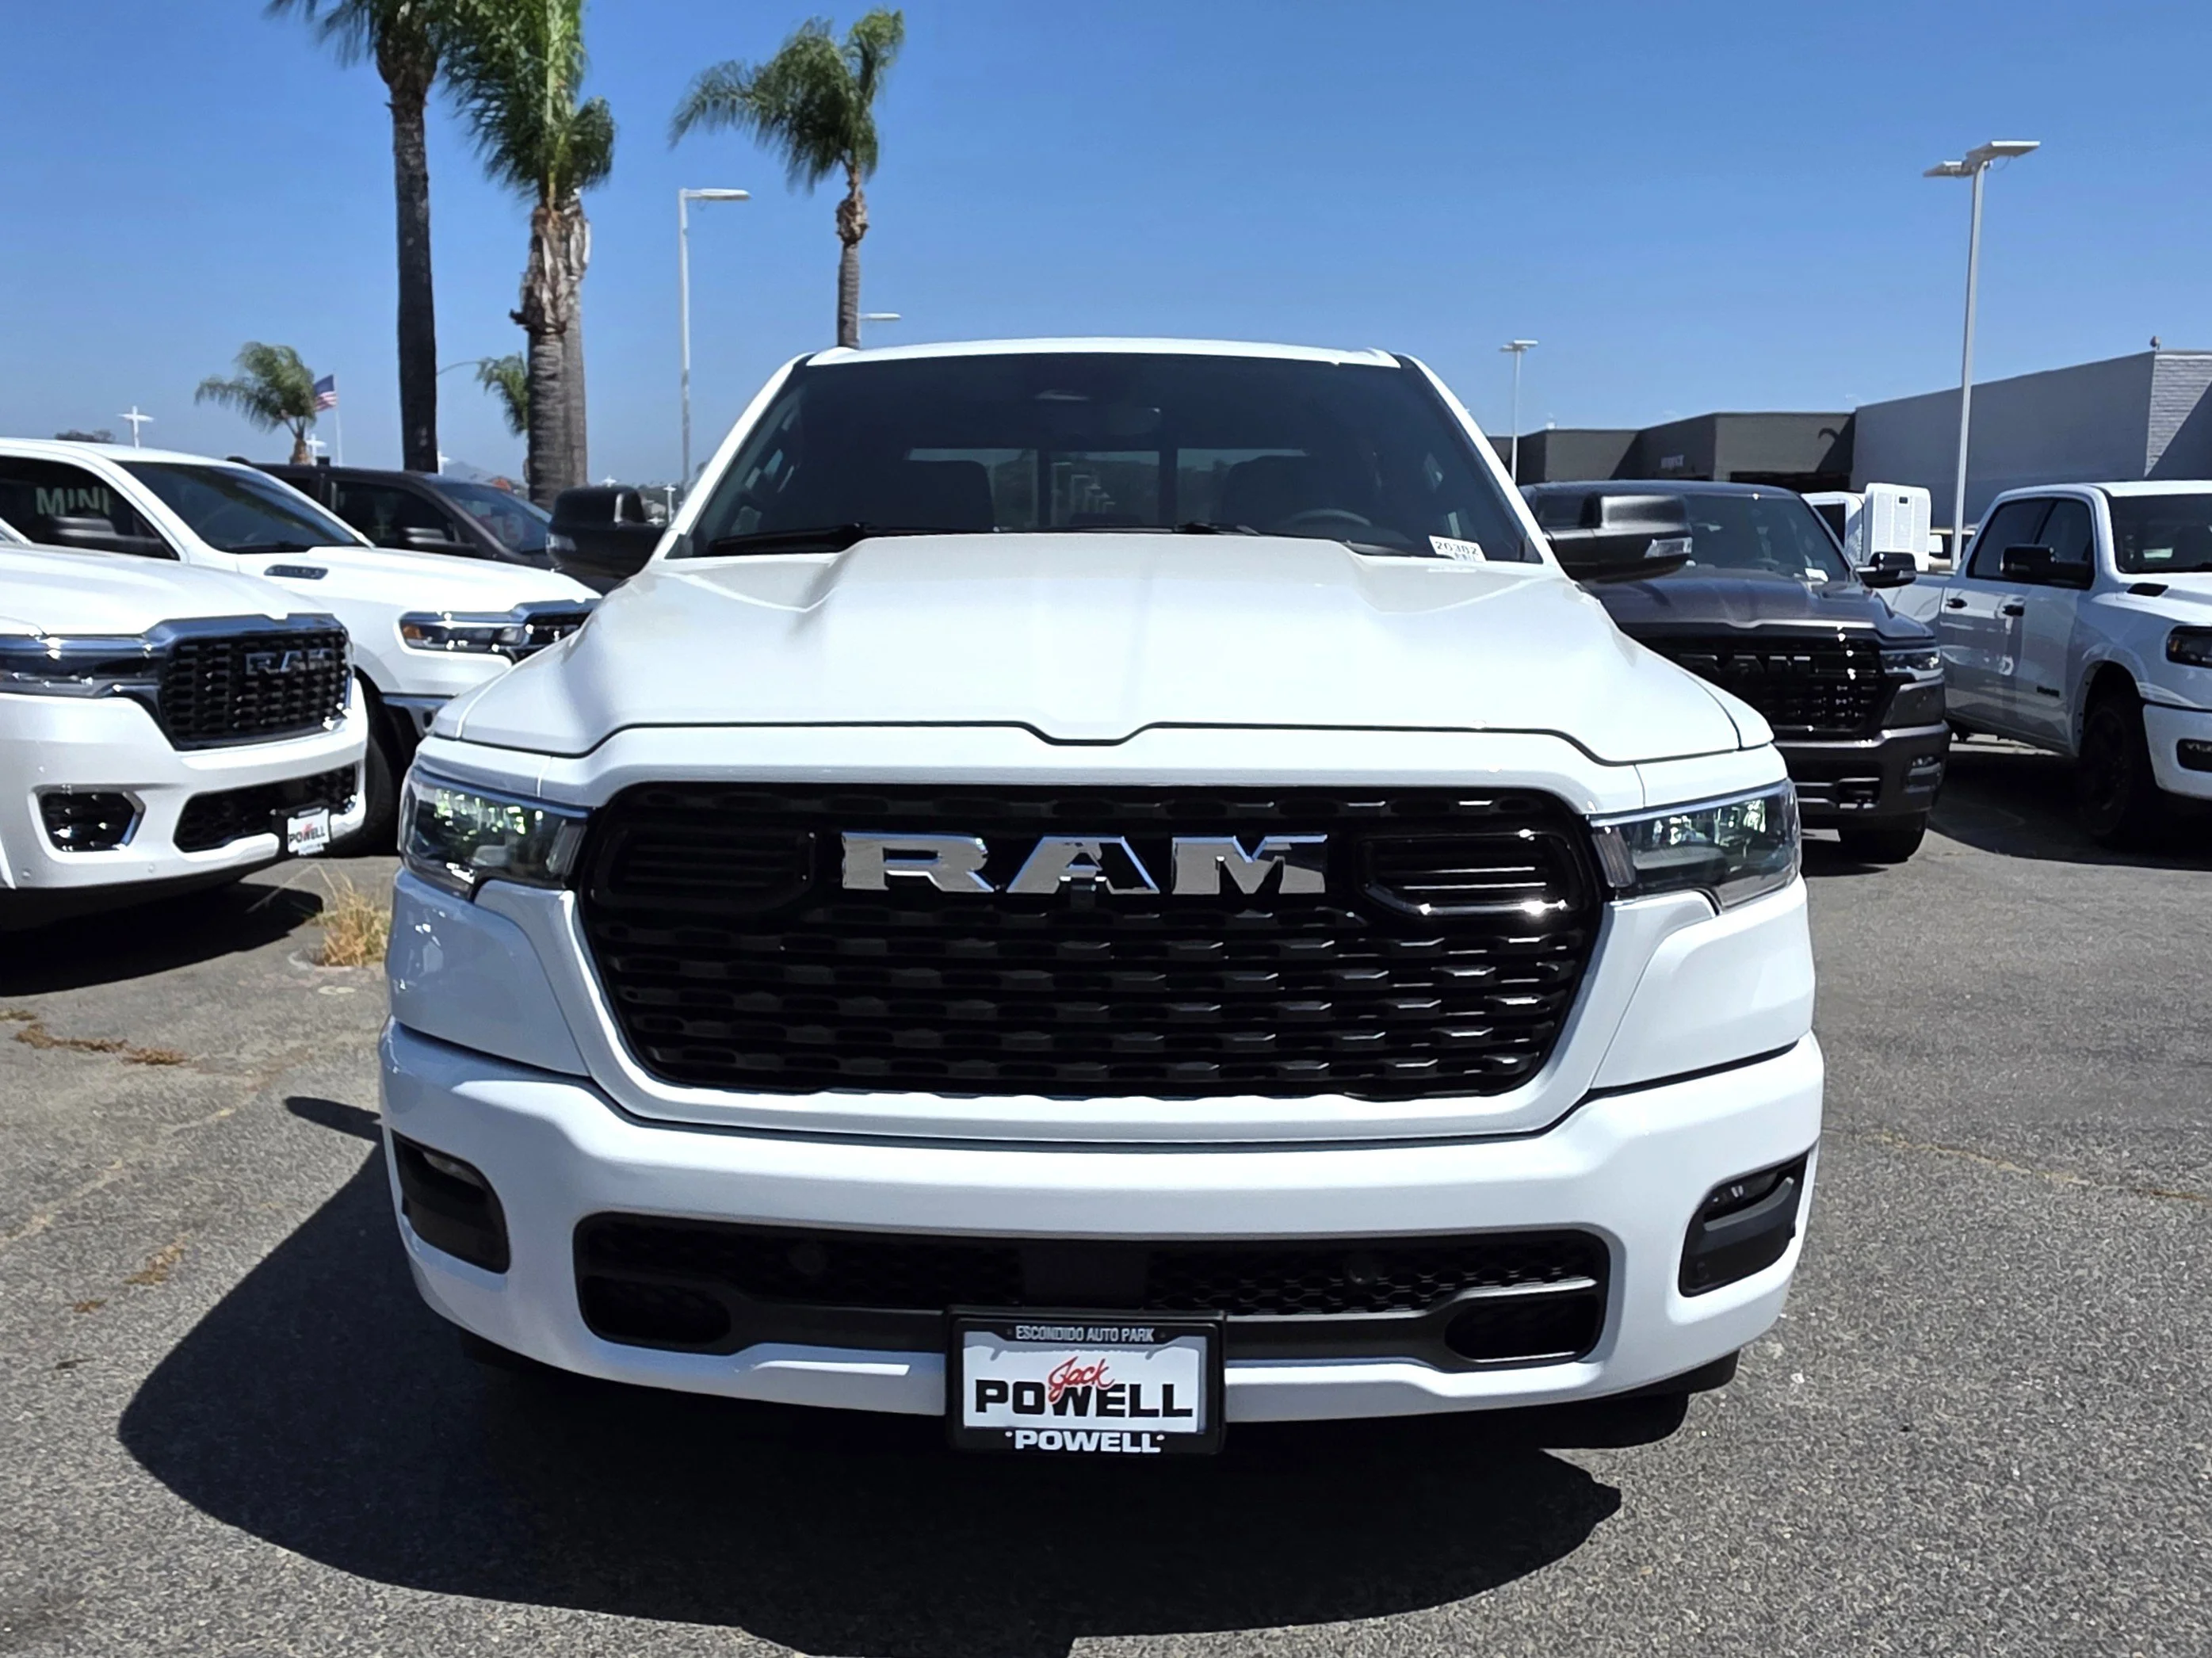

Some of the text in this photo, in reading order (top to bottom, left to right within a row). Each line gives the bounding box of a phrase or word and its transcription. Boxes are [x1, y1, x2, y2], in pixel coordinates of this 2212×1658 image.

[35, 486, 110, 515] MINI
[842, 832, 1328, 895] RAM
[1015, 1325, 1155, 1343] ESCONDIDO AUTO PARK
[1048, 1355, 1114, 1404] Jack
[975, 1379, 1194, 1419] POWELL
[1014, 1429, 1161, 1454] POWELL
